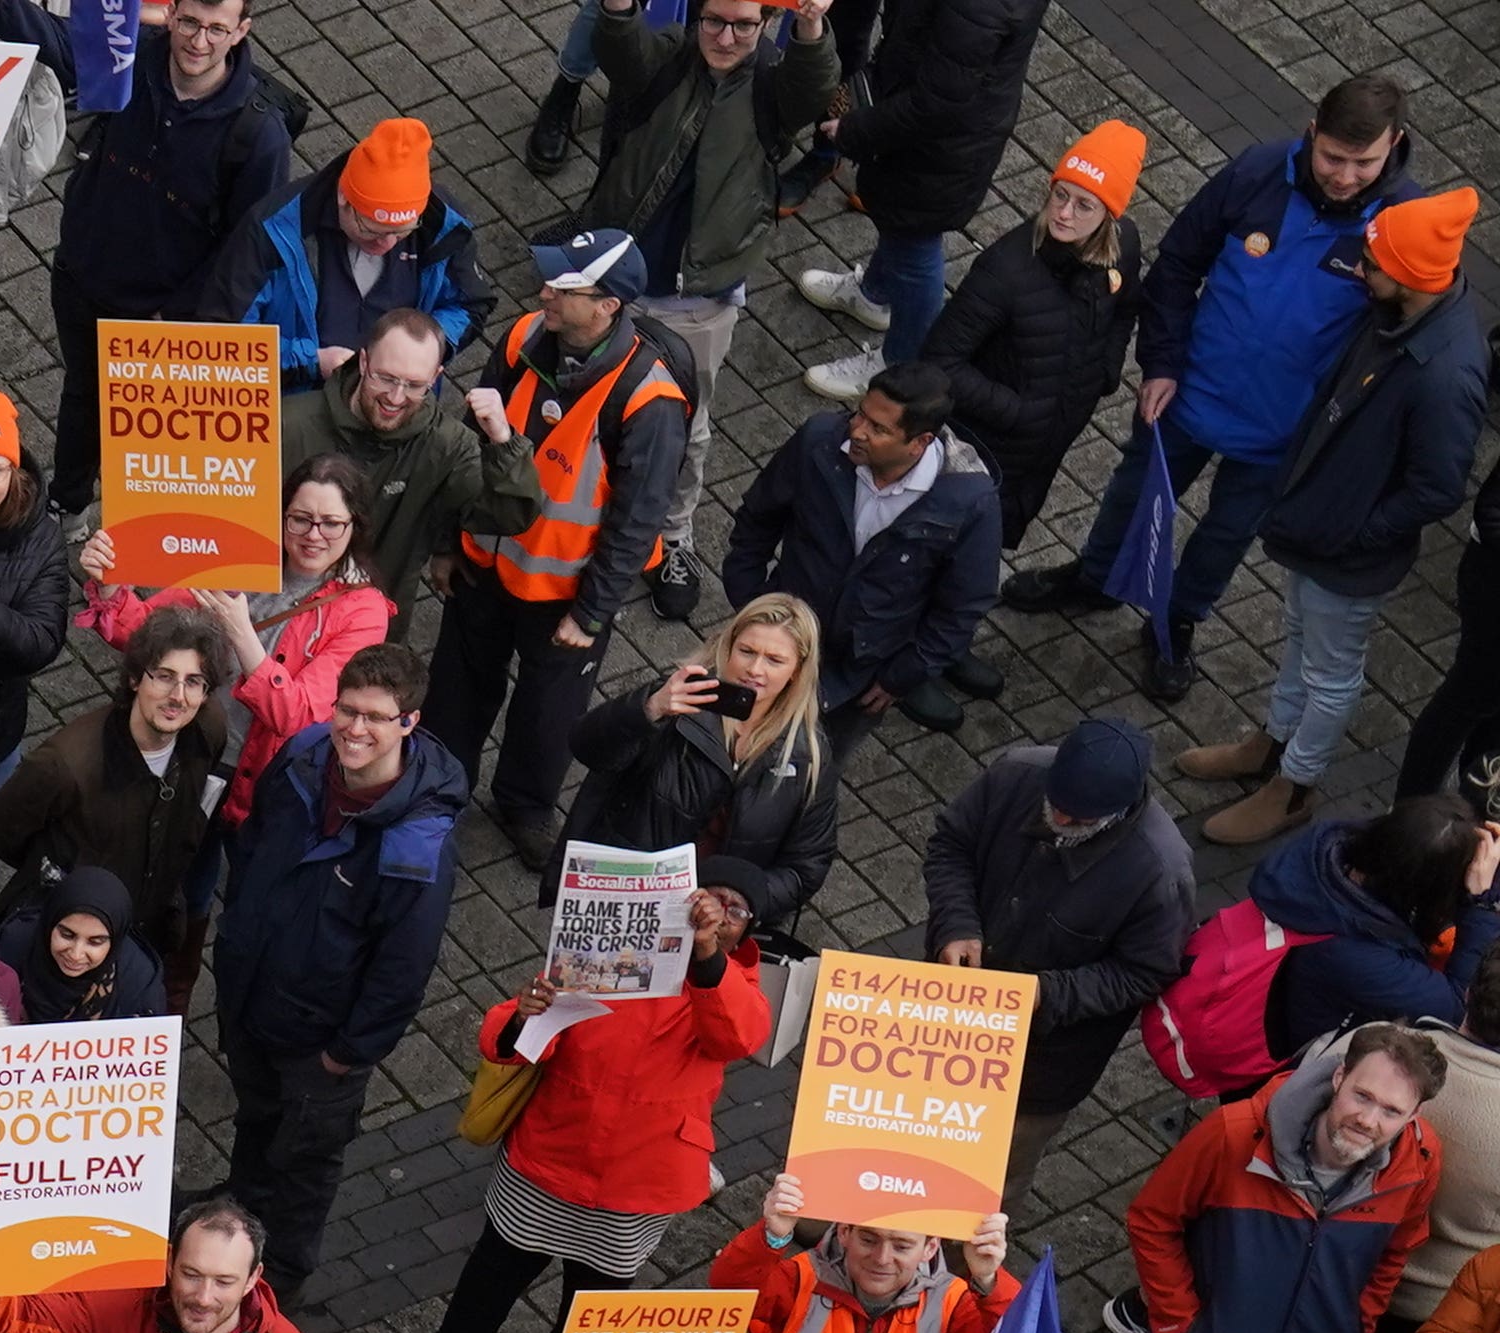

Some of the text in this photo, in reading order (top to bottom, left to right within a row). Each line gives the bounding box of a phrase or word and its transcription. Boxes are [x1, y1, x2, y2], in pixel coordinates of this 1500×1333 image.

[578, 873, 691, 890] Socialist Worker
[562, 899, 660, 918] BLAME THE
[561, 917, 661, 935] TORIES FOR
[556, 933, 654, 952] NHS CRISIS
